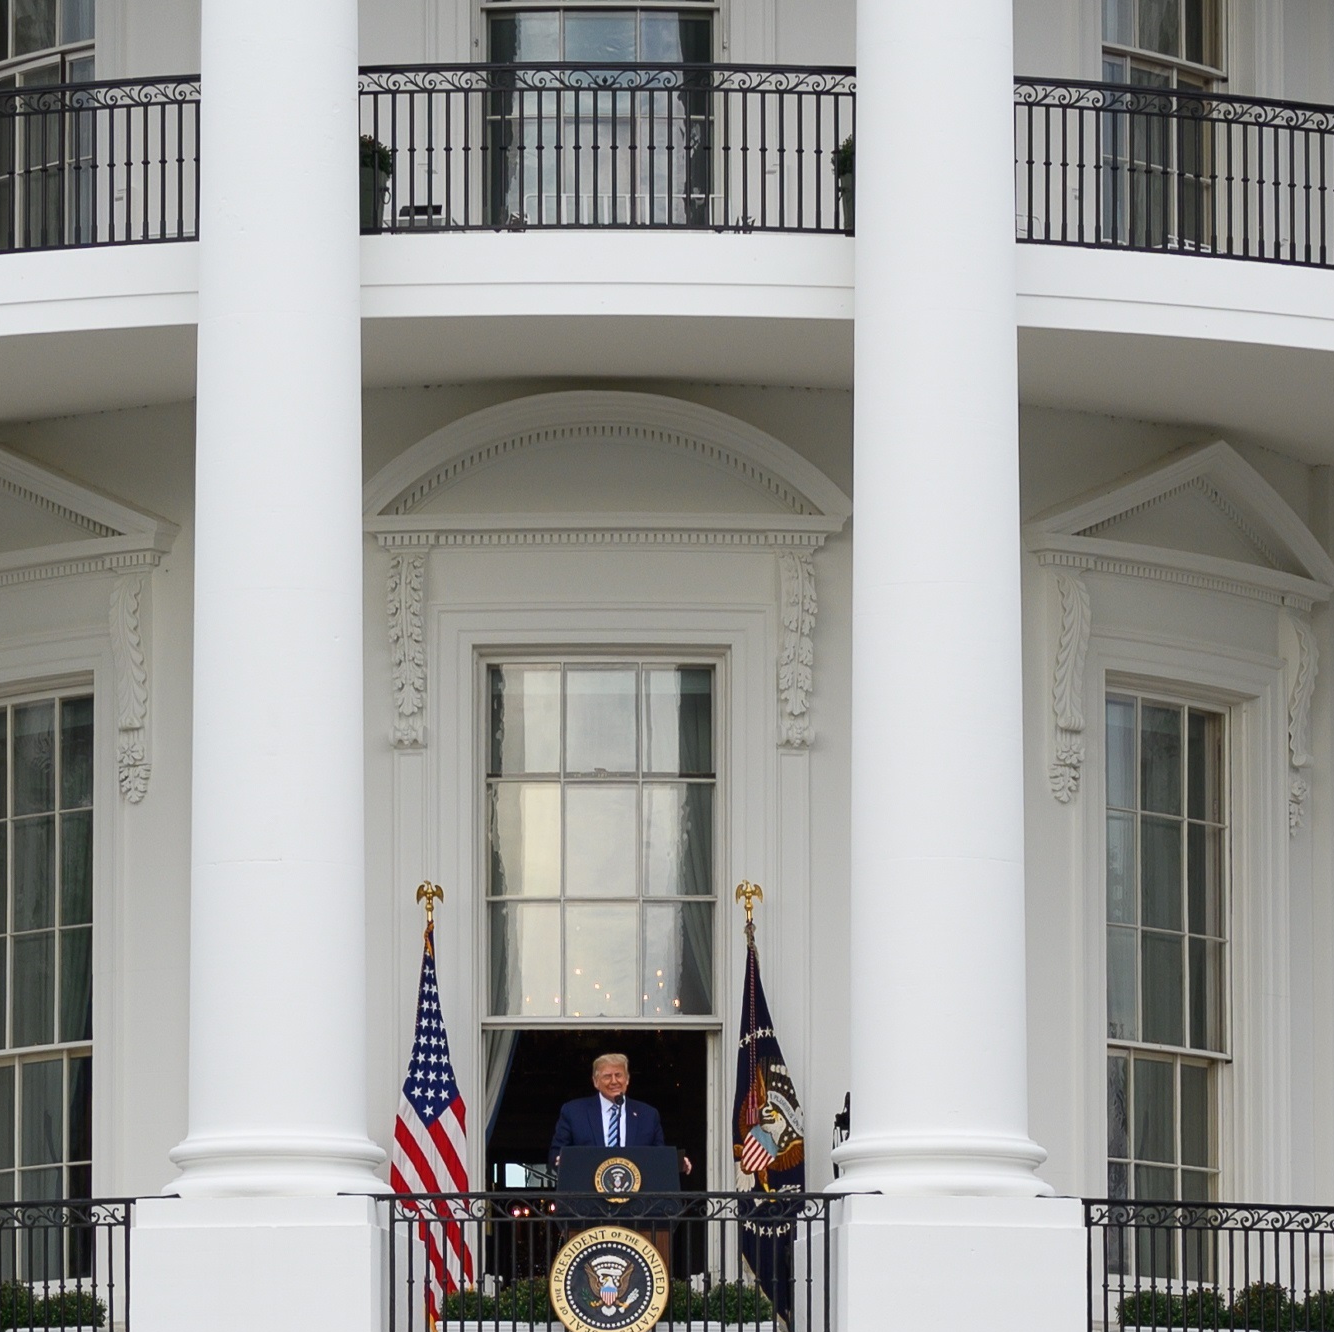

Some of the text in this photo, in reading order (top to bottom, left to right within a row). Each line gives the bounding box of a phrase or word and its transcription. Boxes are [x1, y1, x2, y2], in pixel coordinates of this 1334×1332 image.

[610, 1231, 622, 1239] OF
[624, 1233, 640, 1247] THE
[553, 1229, 606, 1284] PRESIDENT
[641, 1244, 666, 1296] UNITED
[555, 1287, 563, 1305] THE
[561, 1308, 569, 1316] OF
